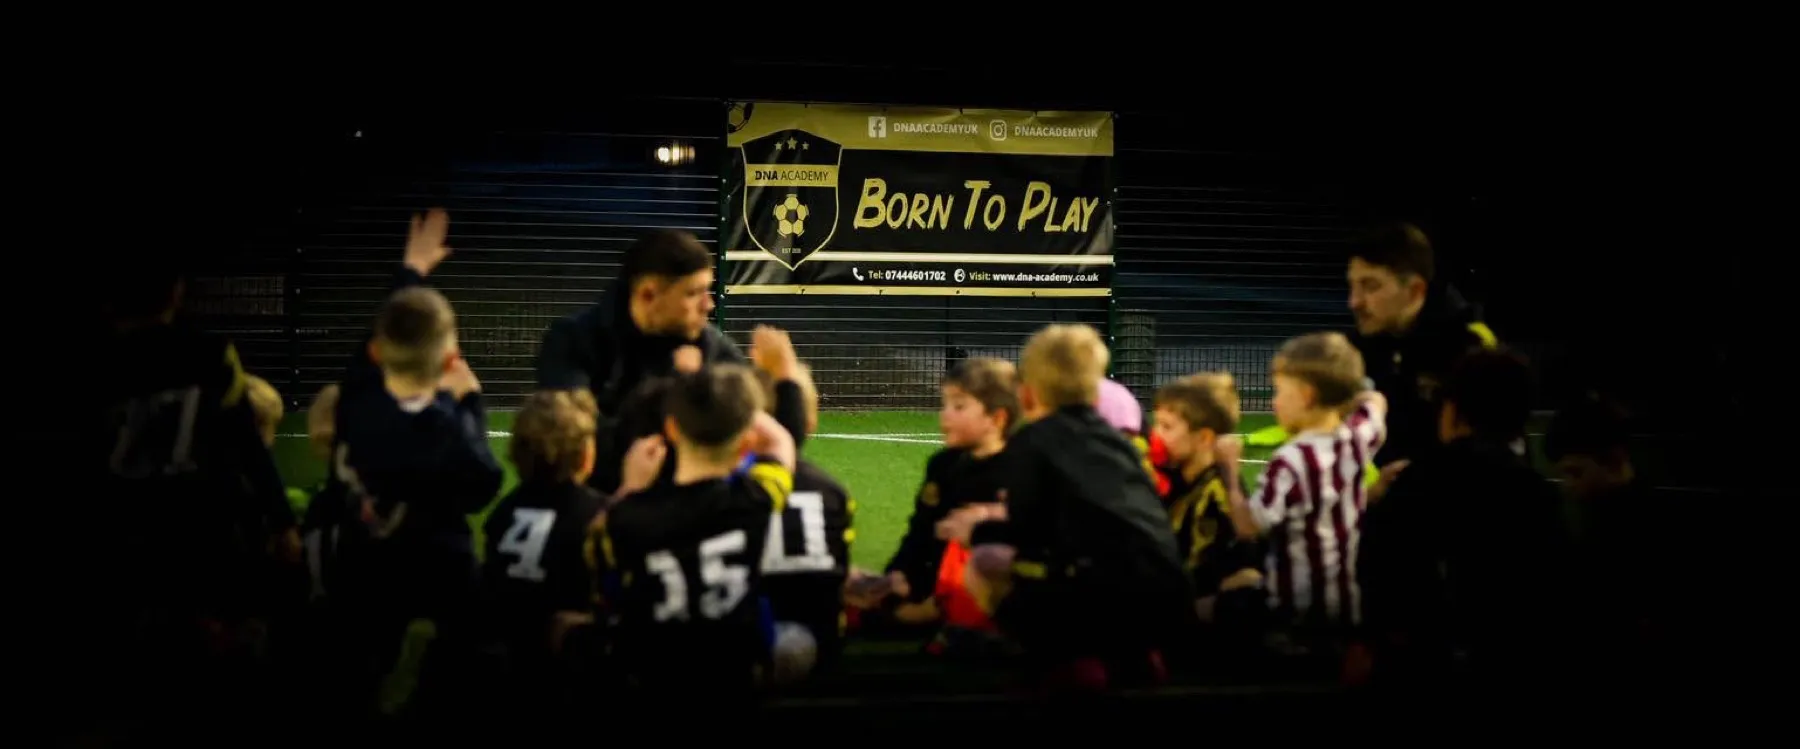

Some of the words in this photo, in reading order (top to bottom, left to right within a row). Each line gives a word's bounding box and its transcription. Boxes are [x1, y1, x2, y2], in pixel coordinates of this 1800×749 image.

[893, 121, 979, 135] DNAACADEMYUK
[1013, 124, 1099, 139] DNAACADEMYUK
[755, 170, 778, 181] DNA
[780, 170, 829, 182] ACADEMY
[868, 269, 884, 281] Tel:
[885, 269, 947, 282] 07444601702
[969, 270, 991, 282] Visit:
[992, 271, 1100, 285] www.dna-academy.co.uk
[497, 505, 560, 583] 4
